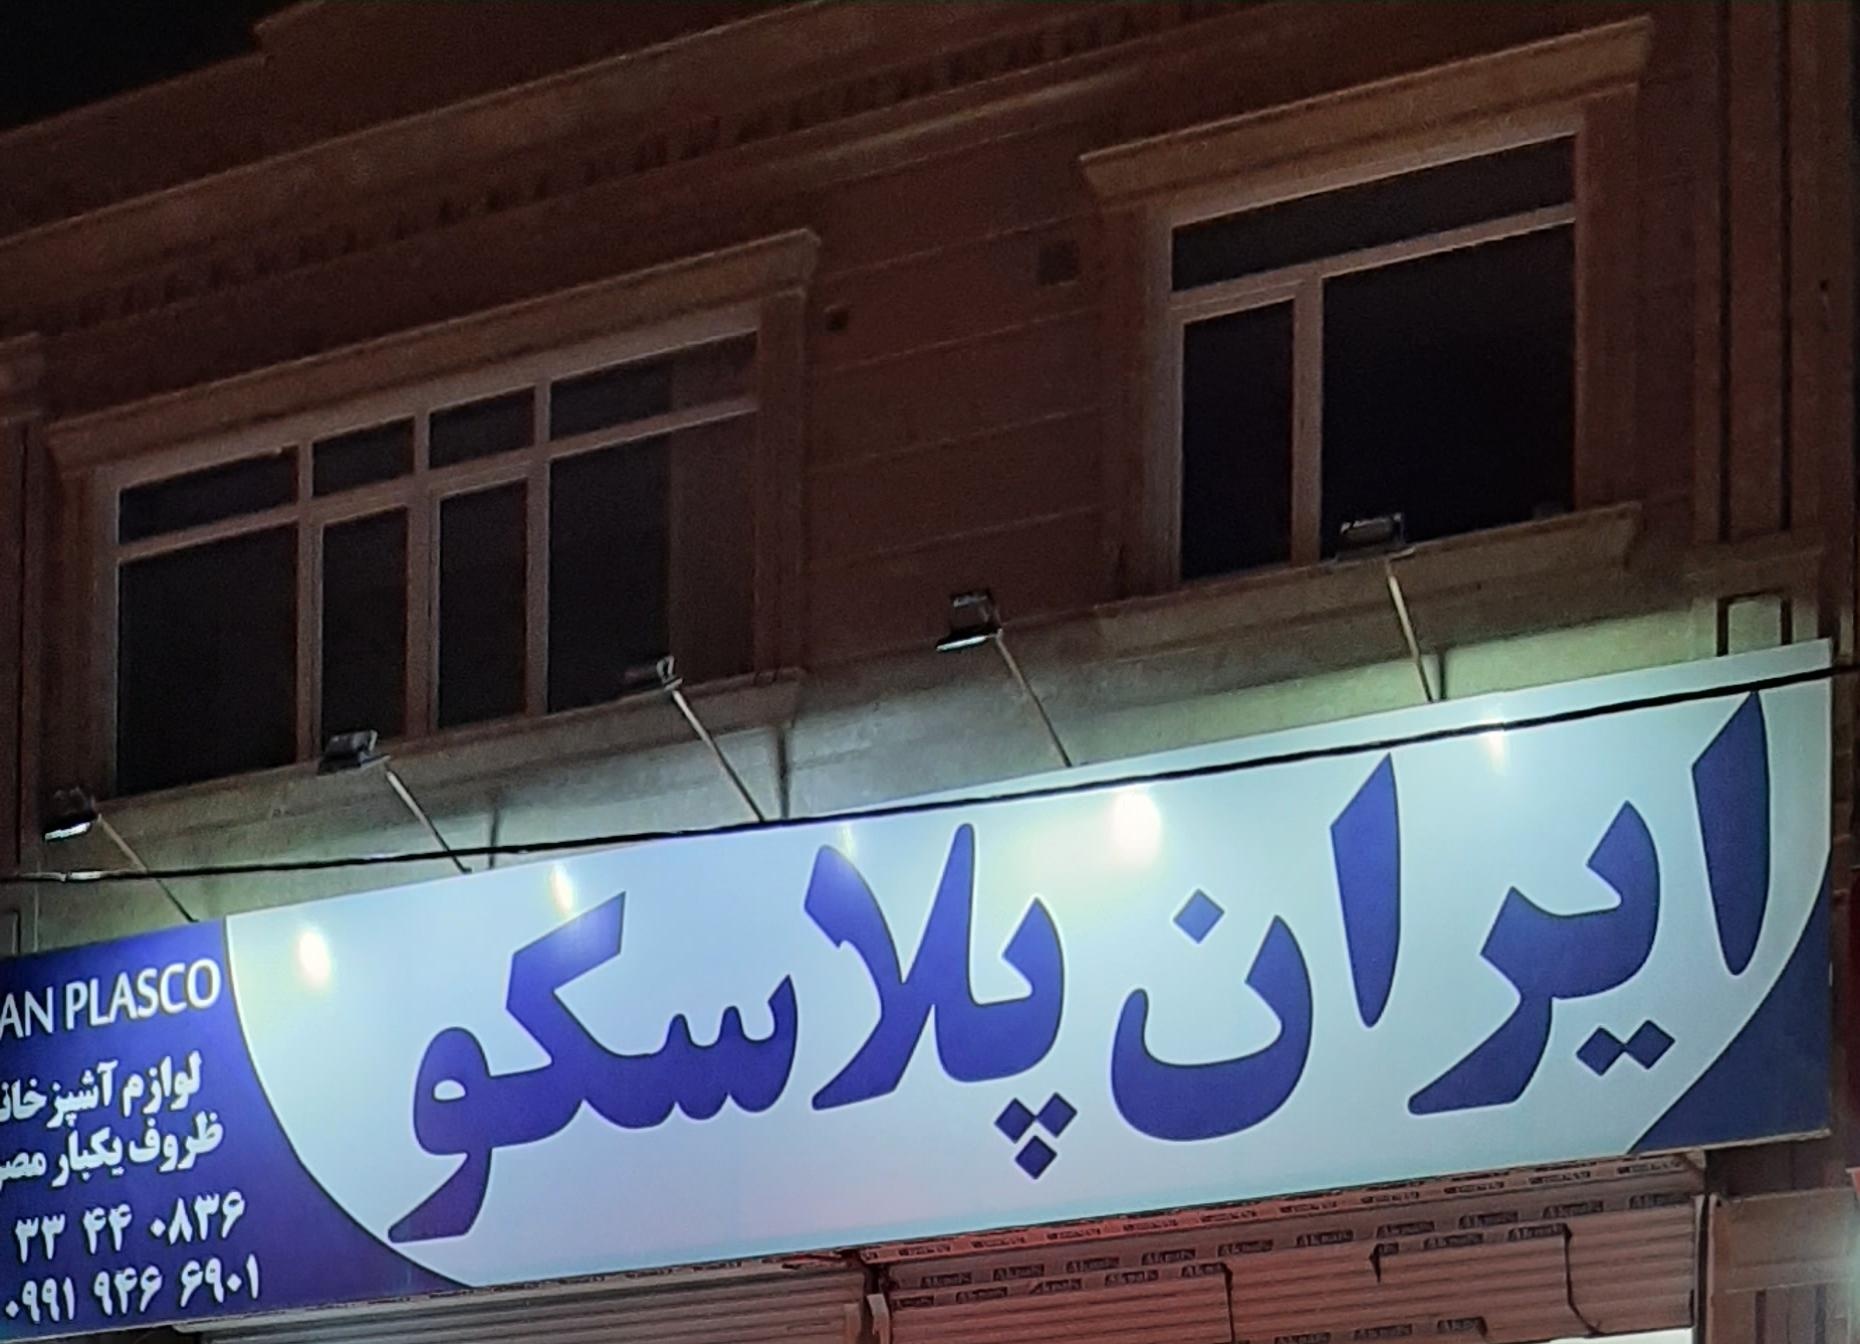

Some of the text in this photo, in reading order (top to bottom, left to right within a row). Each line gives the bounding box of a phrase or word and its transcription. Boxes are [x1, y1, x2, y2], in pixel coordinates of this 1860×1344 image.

[66, 957, 222, 1030] PLASCO
[387, 690, 1774, 1244] ایران پلاسکو
[121, 1050, 203, 1118] لوازم
[51, 1126, 124, 1188] یکبار
[129, 1111, 224, 1172] ظروف
[14, 1189, 246, 1263] ۳۳ ۴۴ ۰۸۳۶
[5, 1254, 260, 1322] ۰۹۹۱ ۹۴۶ ۶۹۰۱
